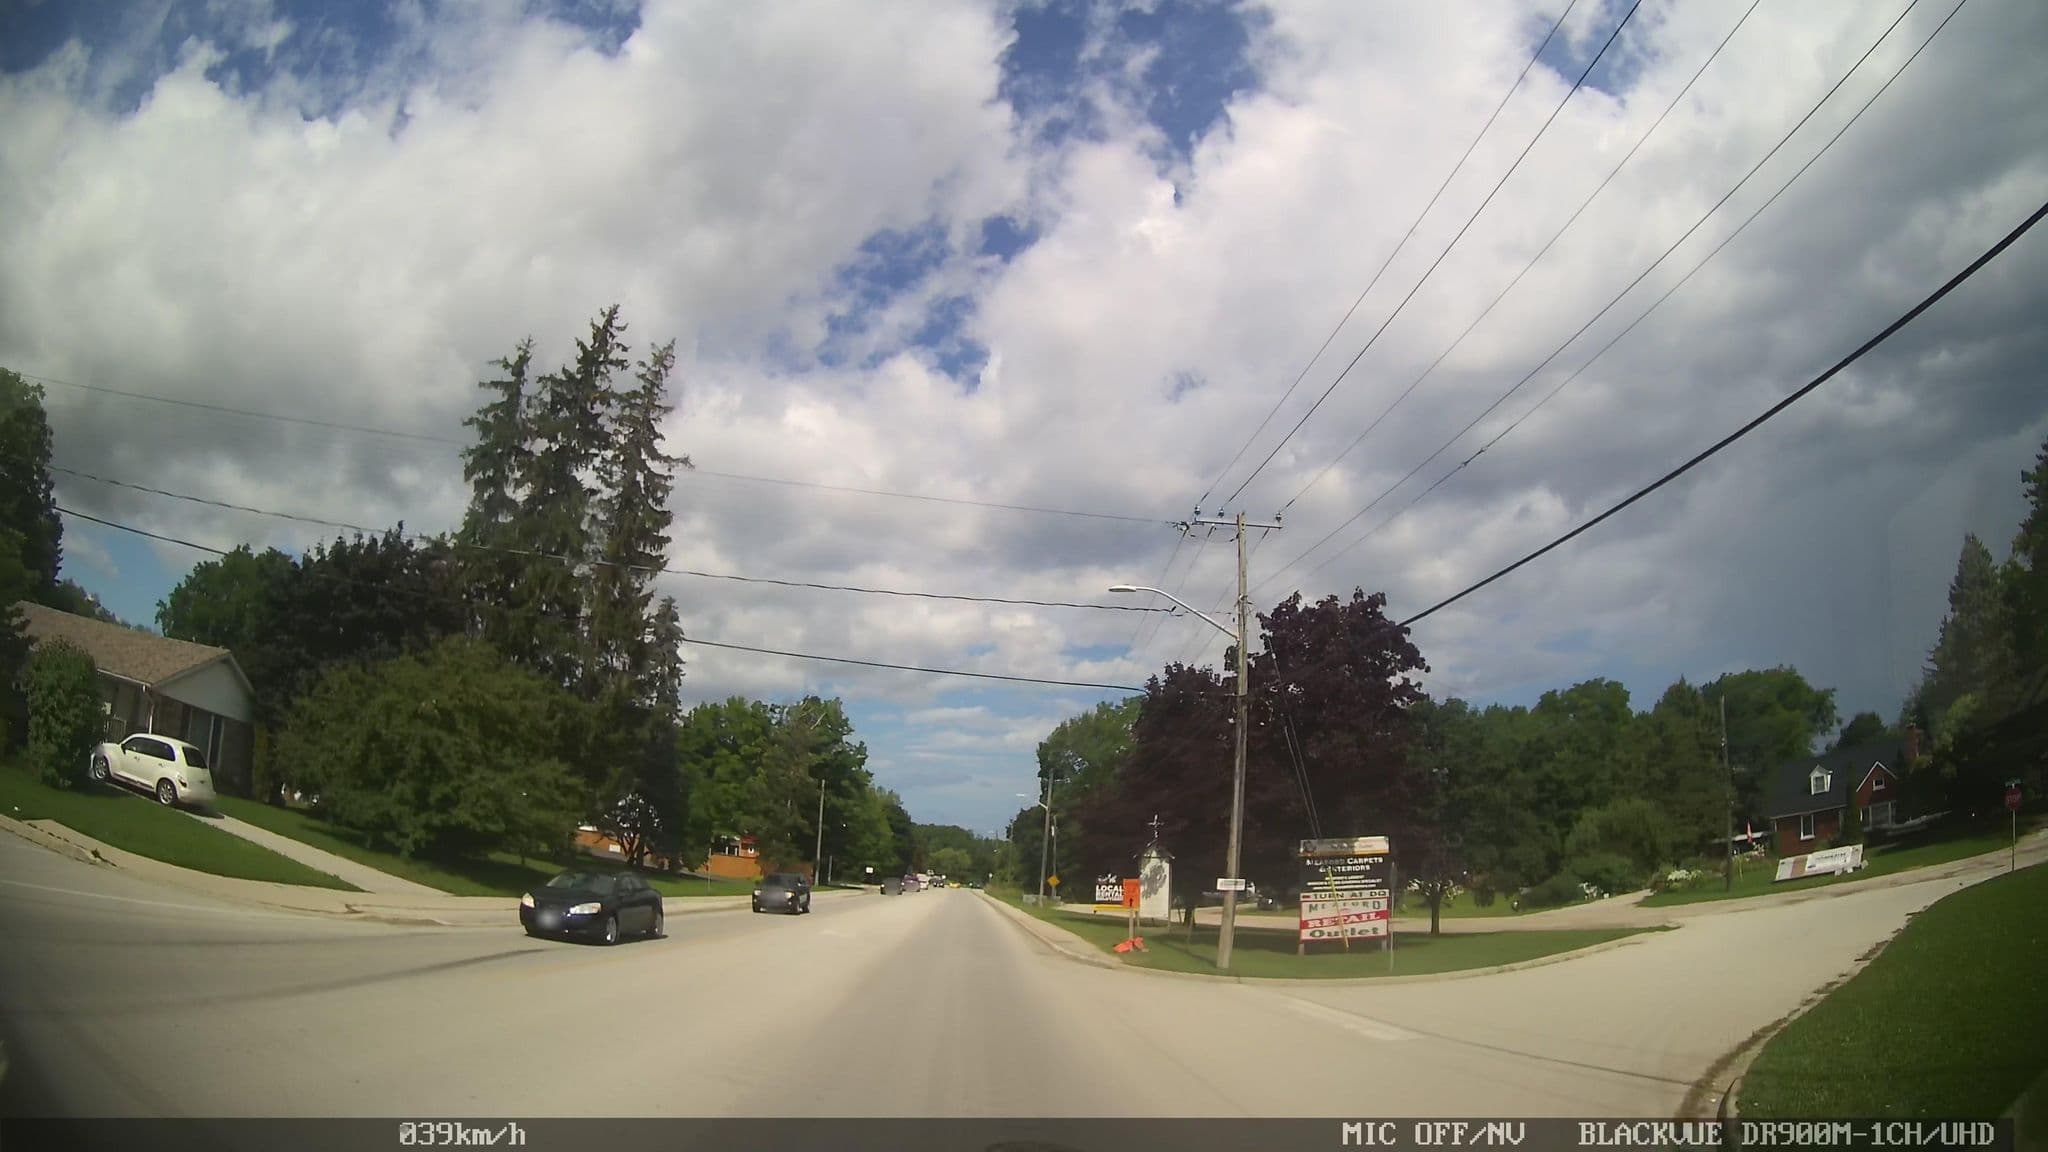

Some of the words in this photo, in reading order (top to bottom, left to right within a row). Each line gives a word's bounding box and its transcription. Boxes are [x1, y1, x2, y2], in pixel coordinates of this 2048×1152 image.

[1347, 857, 1384, 865] CARPETS
[1308, 912, 1381, 928] RETAIL
[1309, 927, 1379, 938] Outlet
